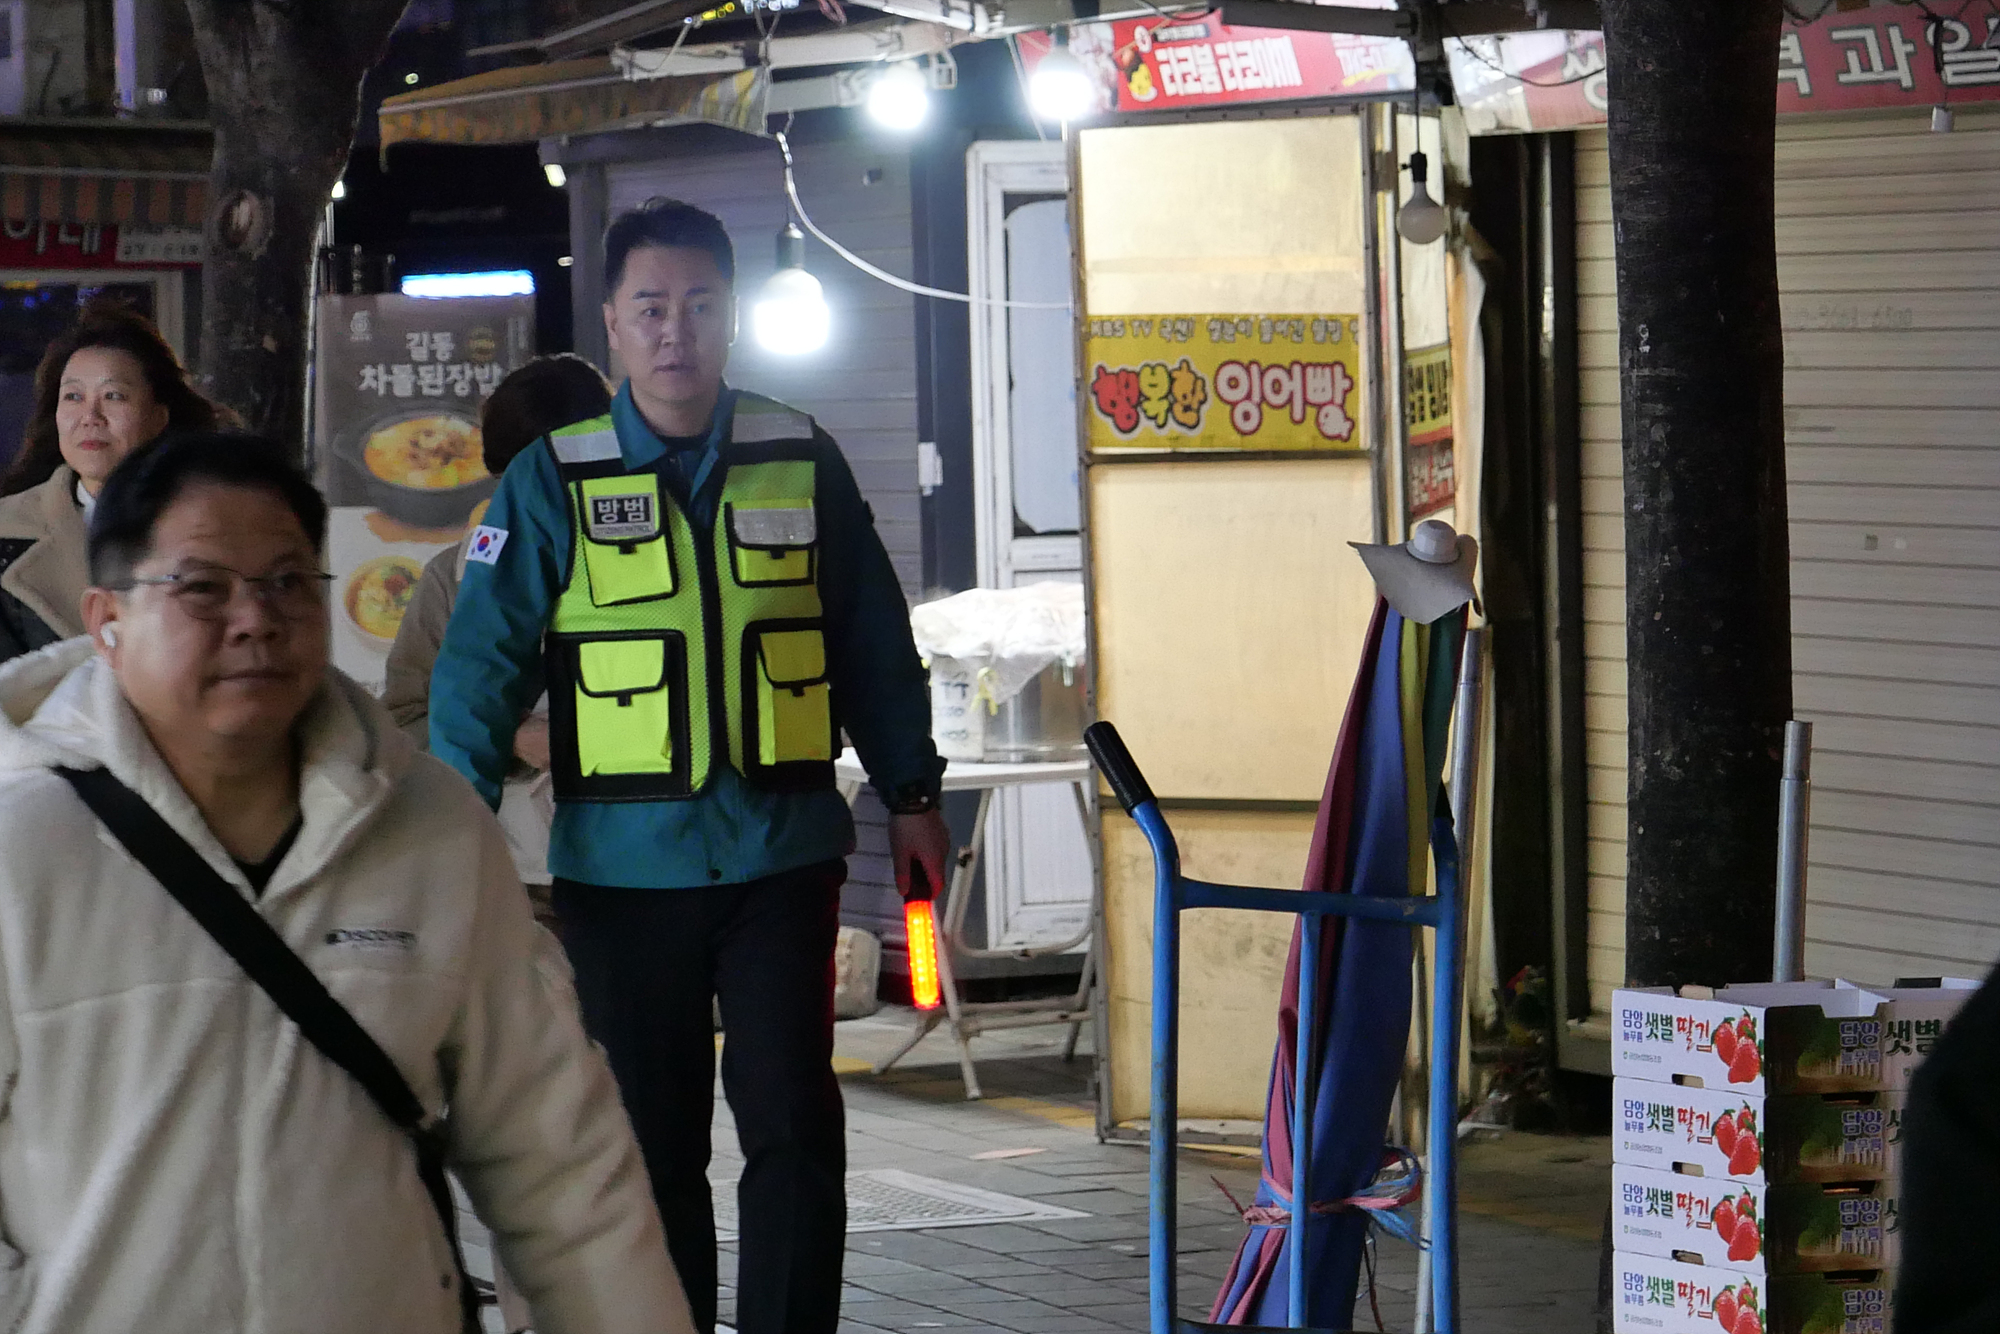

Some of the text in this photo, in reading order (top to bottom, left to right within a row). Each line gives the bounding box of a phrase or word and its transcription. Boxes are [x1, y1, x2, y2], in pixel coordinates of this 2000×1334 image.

[1131, 319, 1153, 338] TV
[1090, 357, 1211, 437] 행복한
[1214, 359, 1355, 442] 잉어빵
[597, 497, 646, 524] 방범
[1622, 1009, 1713, 1054] 담양 샛별 딸기
[1840, 1021, 1881, 1047] 담양
[1624, 1099, 1713, 1145] 담양 샛별 딸기
[1842, 1109, 1883, 1135] 담양
[1623, 1183, 1712, 1230] 담양 샛별 딸기
[1840, 1198, 1882, 1224] 담양
[1623, 1272, 1713, 1320] 담양 샛별 딸기
[1843, 1289, 1885, 1315] 담양
